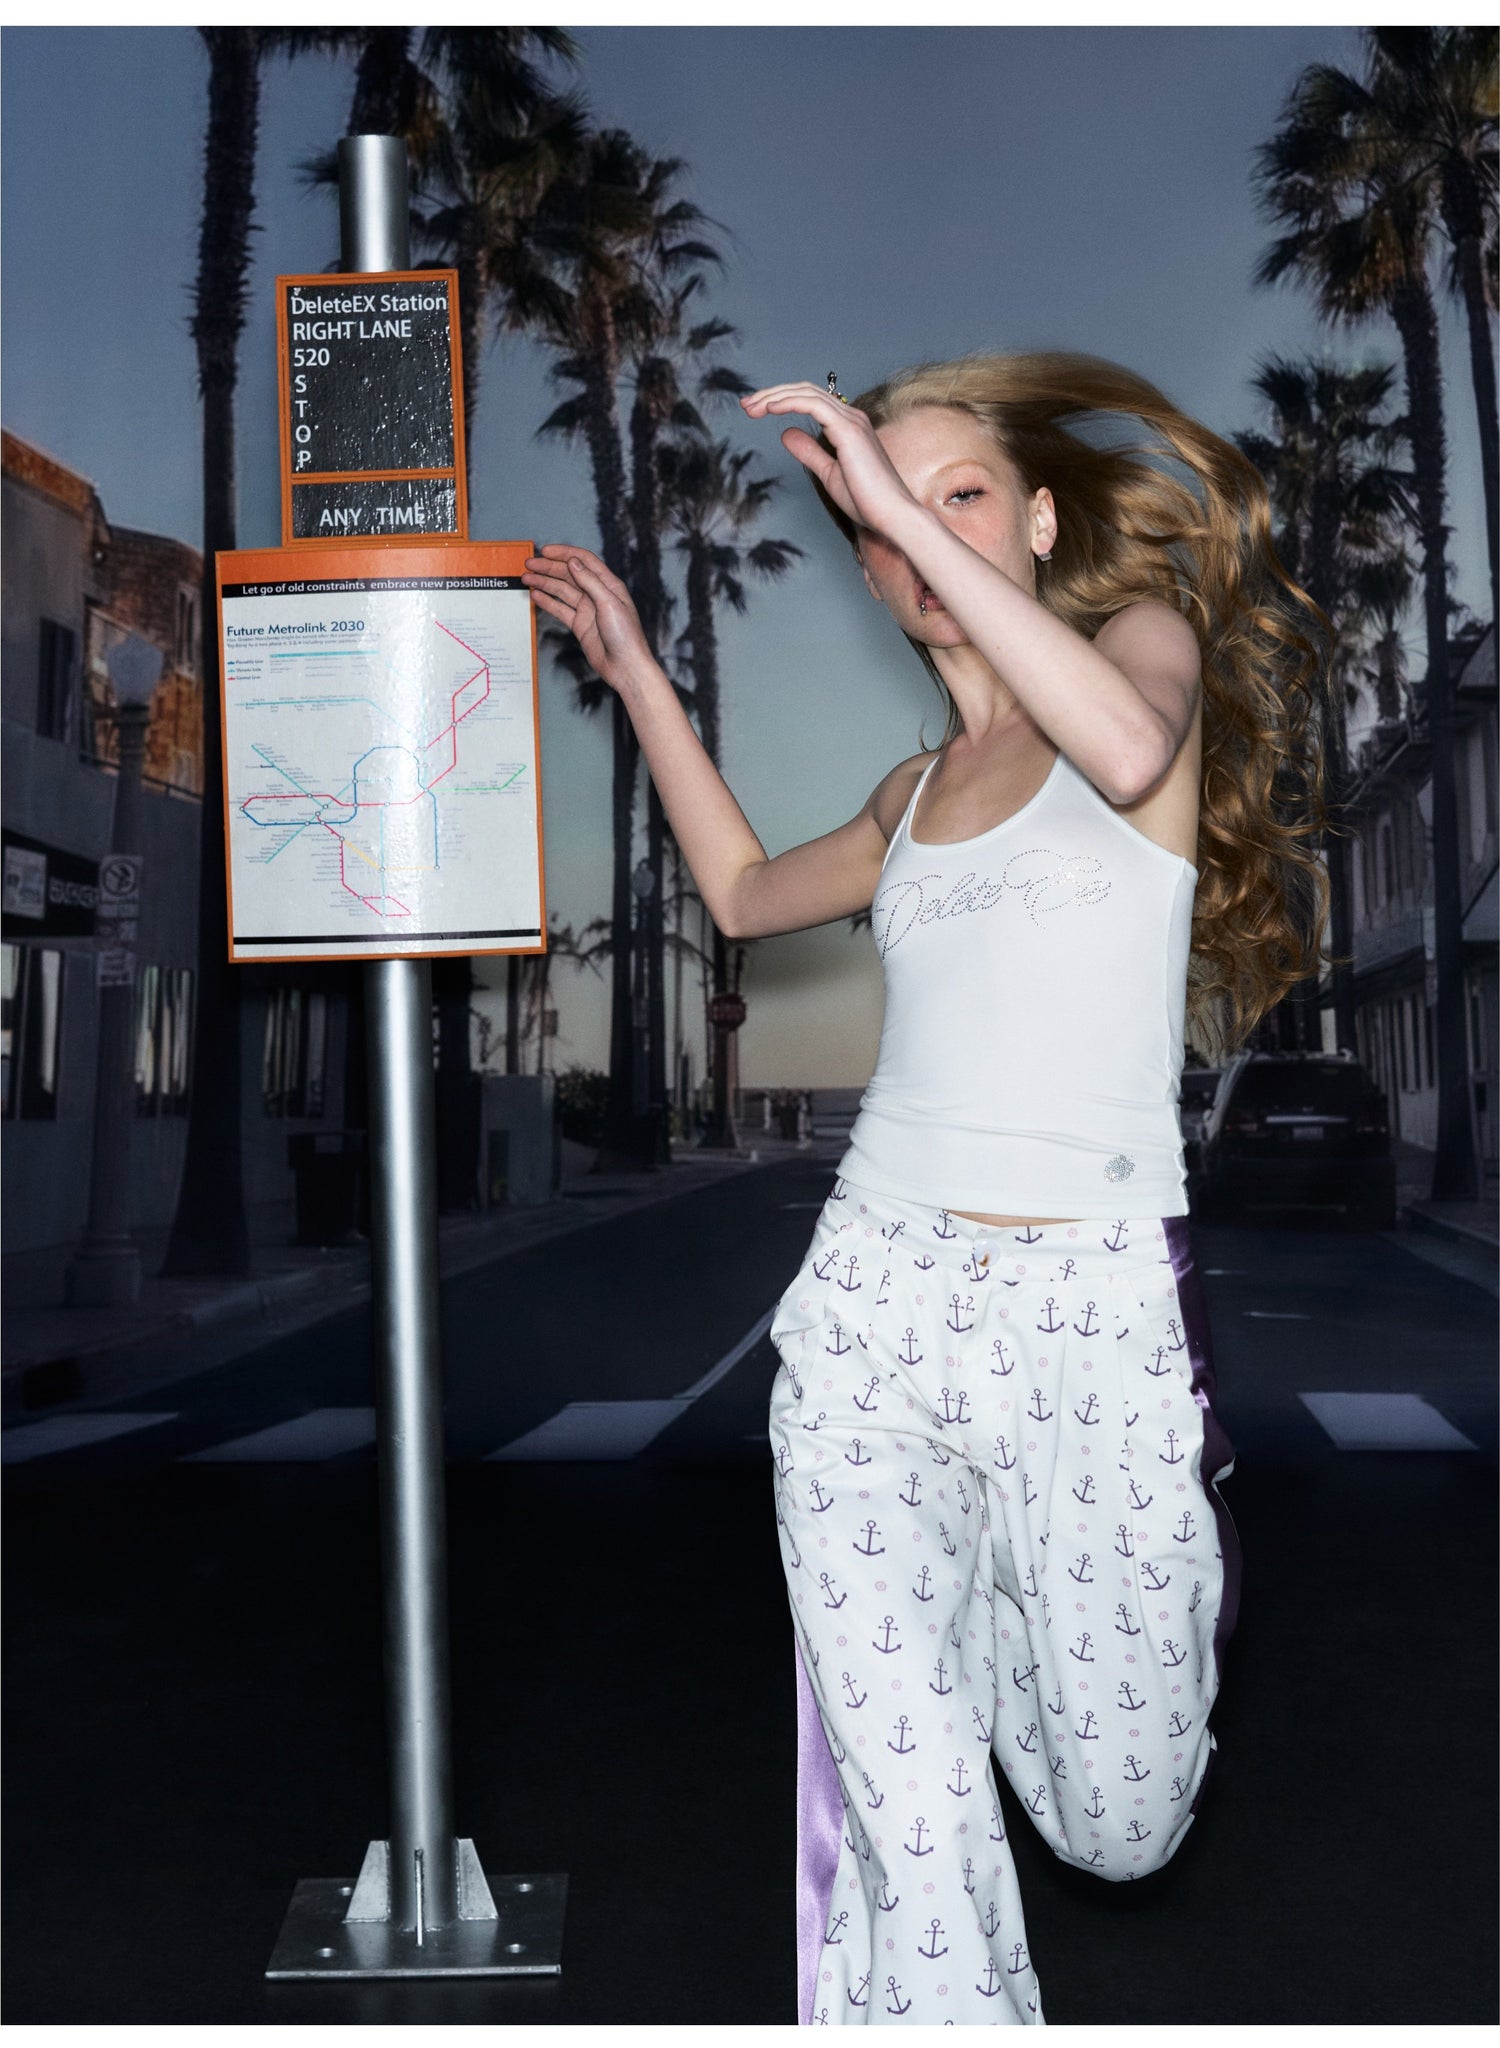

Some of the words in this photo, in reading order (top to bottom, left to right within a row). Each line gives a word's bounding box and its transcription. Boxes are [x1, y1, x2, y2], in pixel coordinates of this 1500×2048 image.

[291, 295, 376, 315] DeleteEX
[380, 293, 447, 312] Station
[293, 321, 356, 341] RIGHT
[360, 319, 412, 338] LANE
[293, 348, 330, 367] 520
[295, 374, 311, 469] STOP
[319, 508, 362, 527] ANY
[376, 505, 426, 526] TIME
[242, 585, 258, 595] Let
[260, 586, 273, 596] go
[275, 583, 286, 593] of
[288, 582, 304, 592] old
[306, 580, 366, 591] constraints
[370, 579, 418, 590] embrace
[420, 579, 444, 588] new
[446, 578, 509, 590] possibilities
[227, 625, 264, 636] Future
[268, 622, 327, 635] Metrolink
[331, 620, 365, 632] 2030
